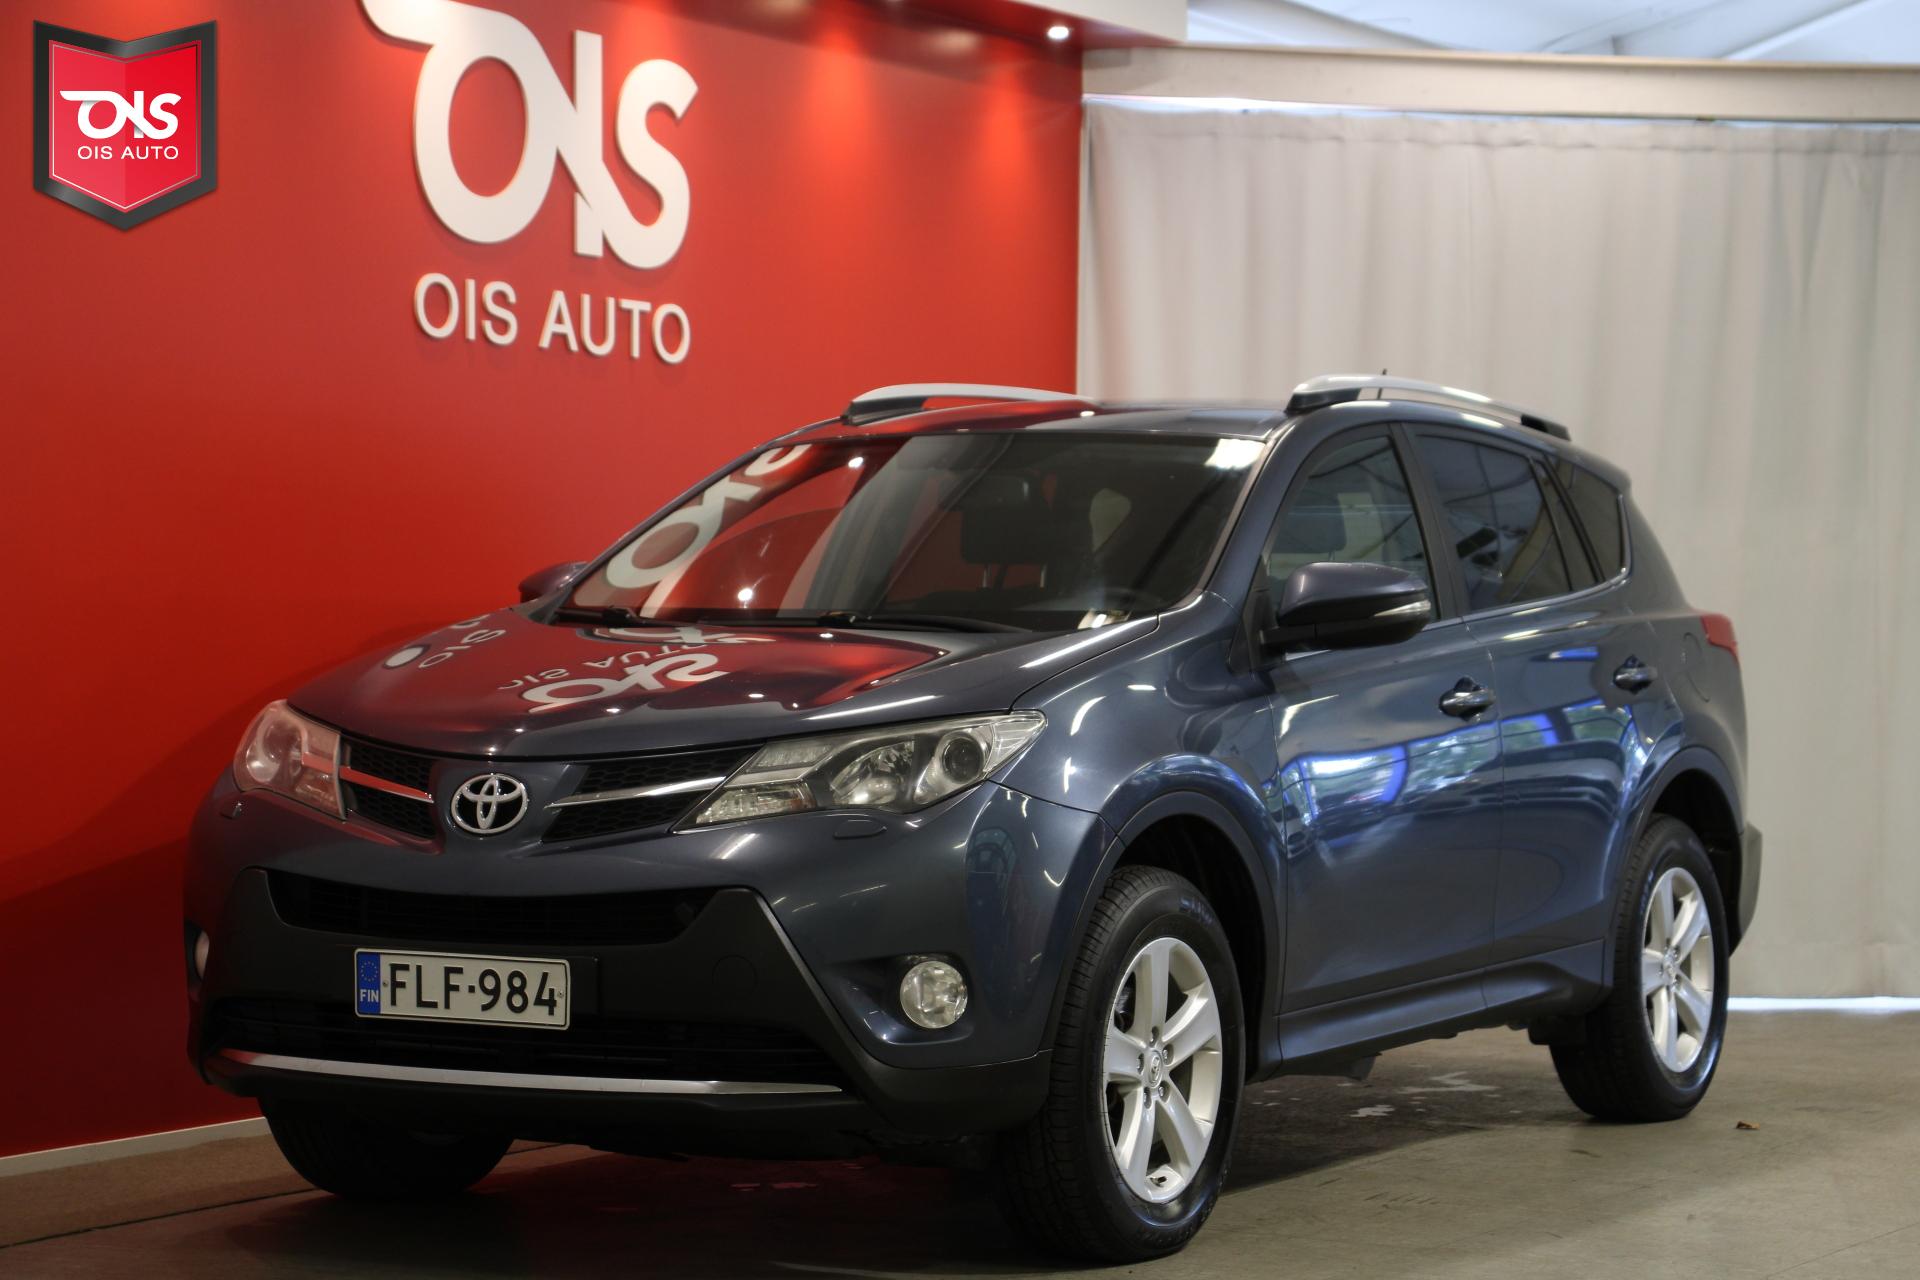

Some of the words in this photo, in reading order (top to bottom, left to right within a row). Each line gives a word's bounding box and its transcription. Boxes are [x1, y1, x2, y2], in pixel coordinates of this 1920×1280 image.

[361, 0, 698, 269] OIS
[414, 272, 518, 346] OIS
[538, 289, 691, 365] AUTO
[359, 988, 380, 1004] FIN
[388, 962, 558, 1017] FLF-984
